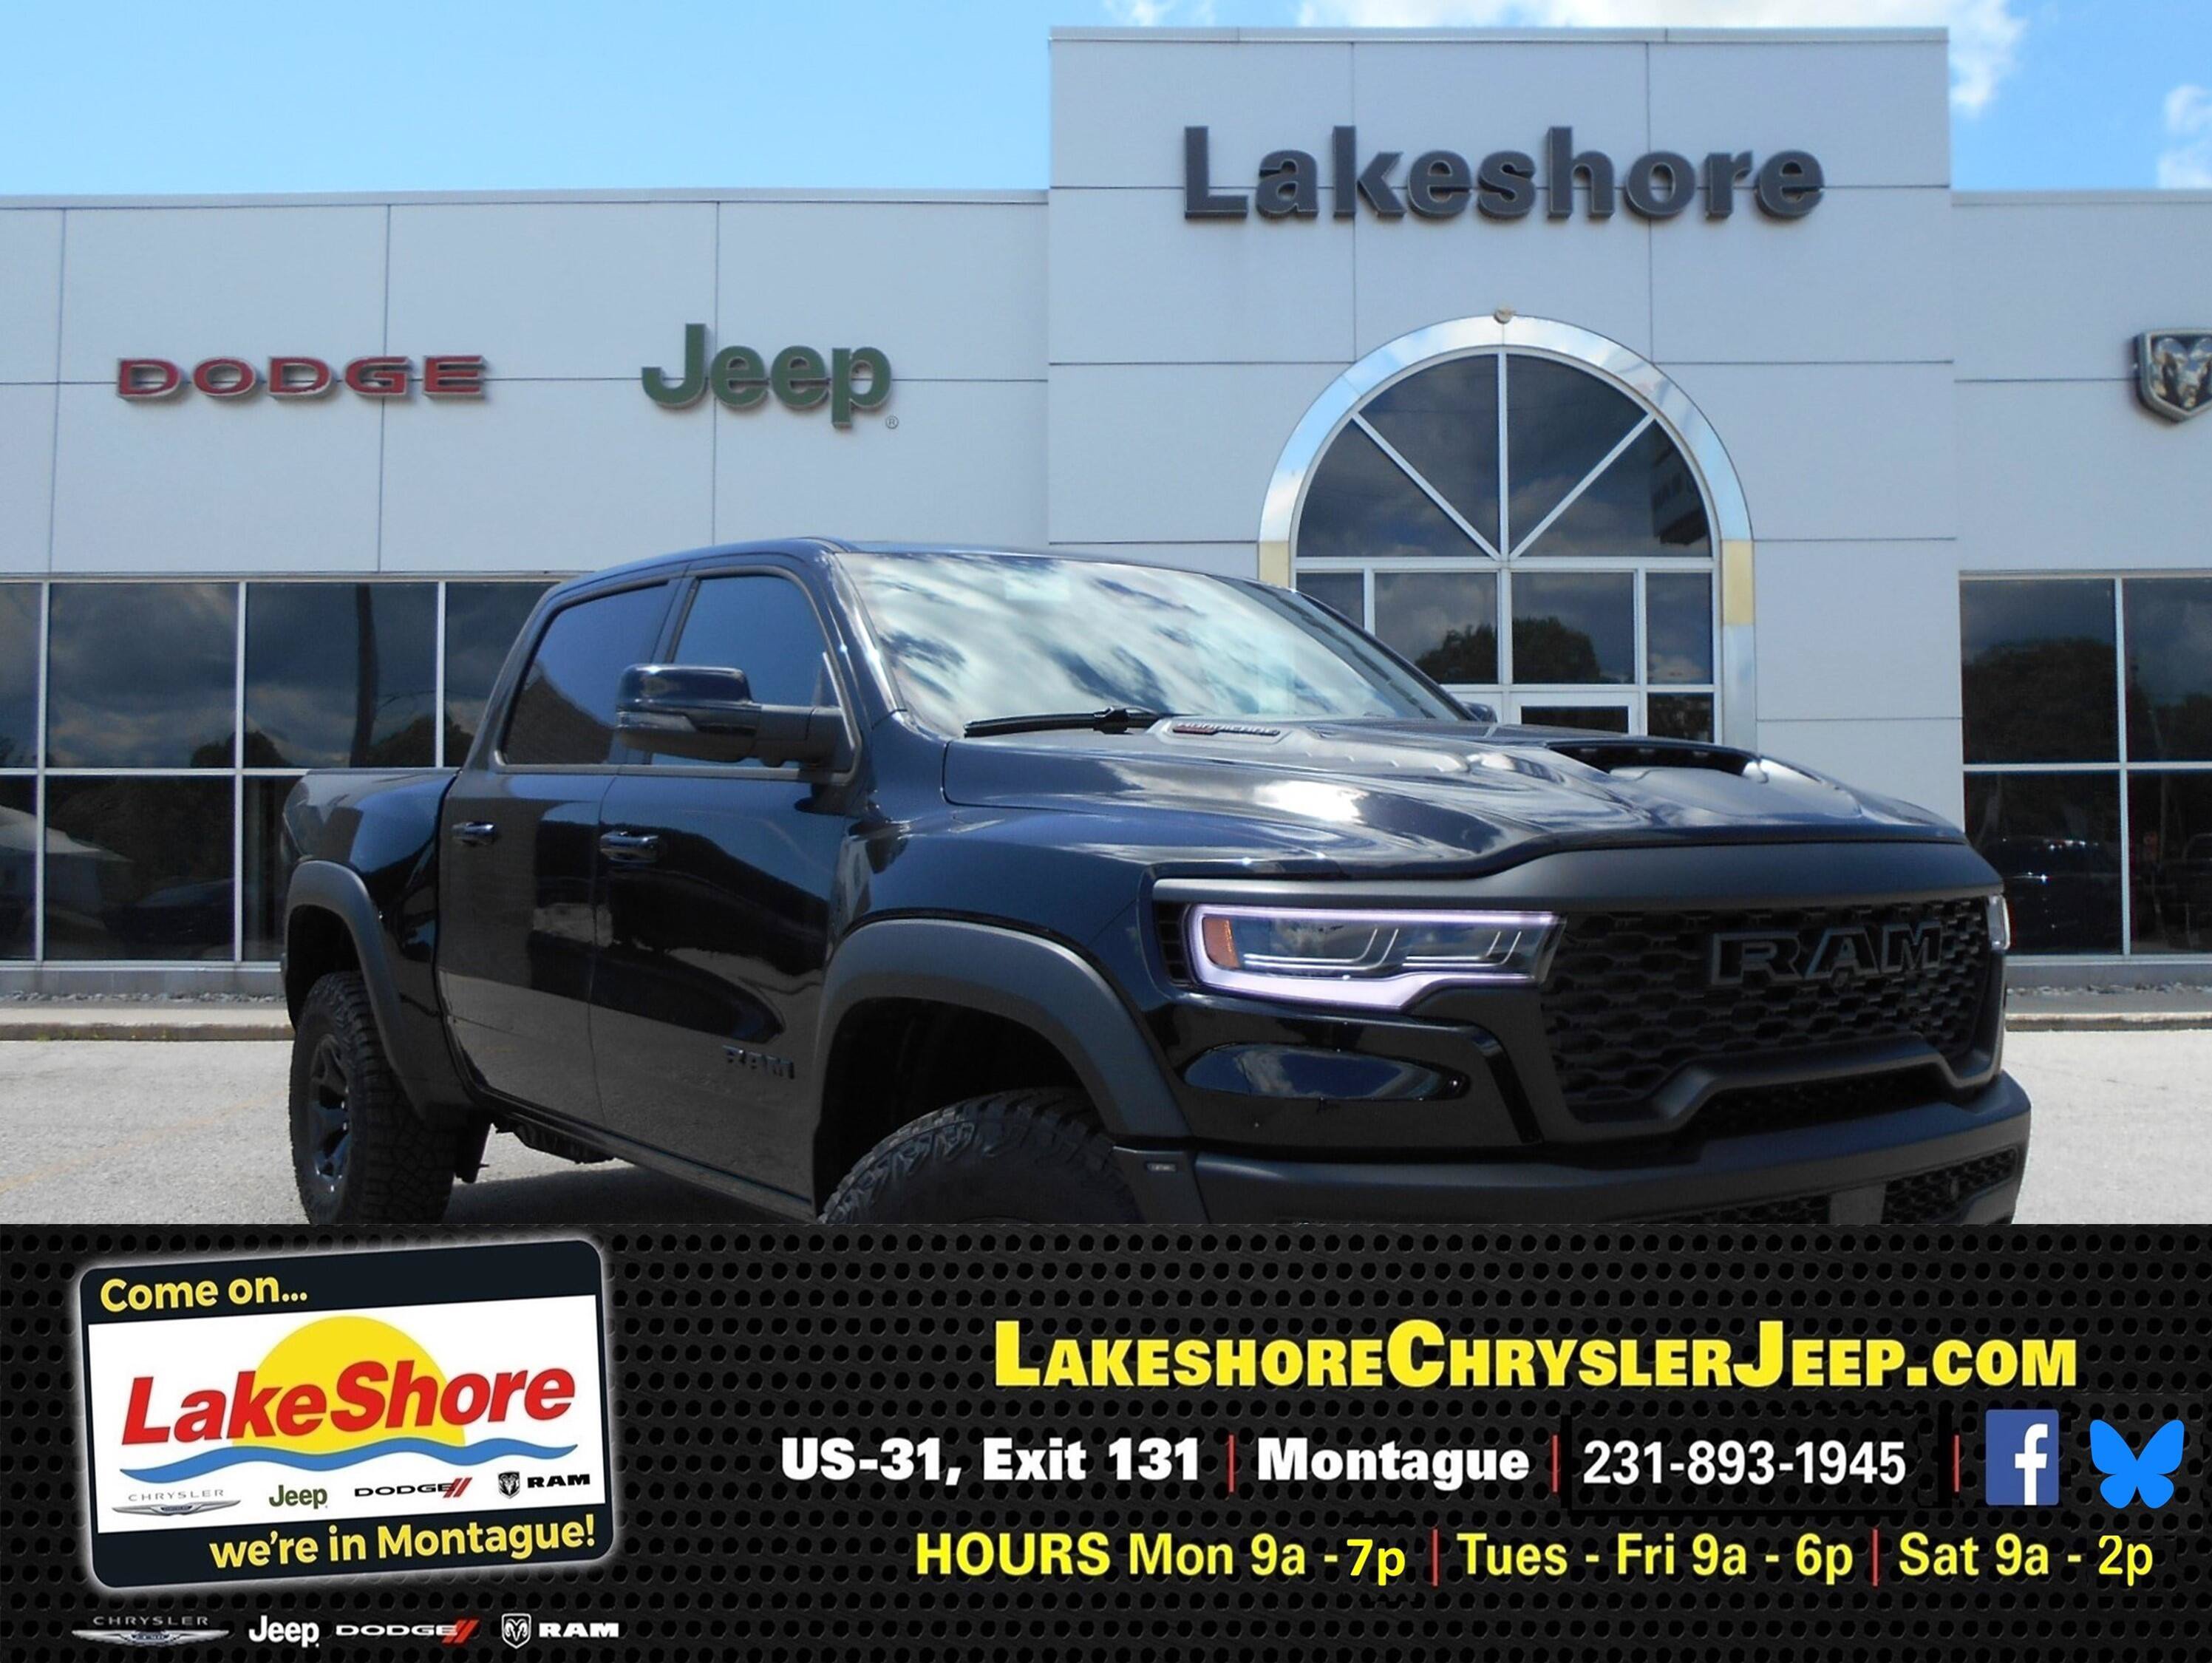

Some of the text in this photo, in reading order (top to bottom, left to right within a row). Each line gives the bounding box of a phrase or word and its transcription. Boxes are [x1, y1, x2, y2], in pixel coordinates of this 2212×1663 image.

[1184, 125, 1825, 220] Lakeshore
[117, 355, 488, 401] DODGE
[641, 322, 893, 429] Jeep
[1710, 921, 1943, 986] RAM
